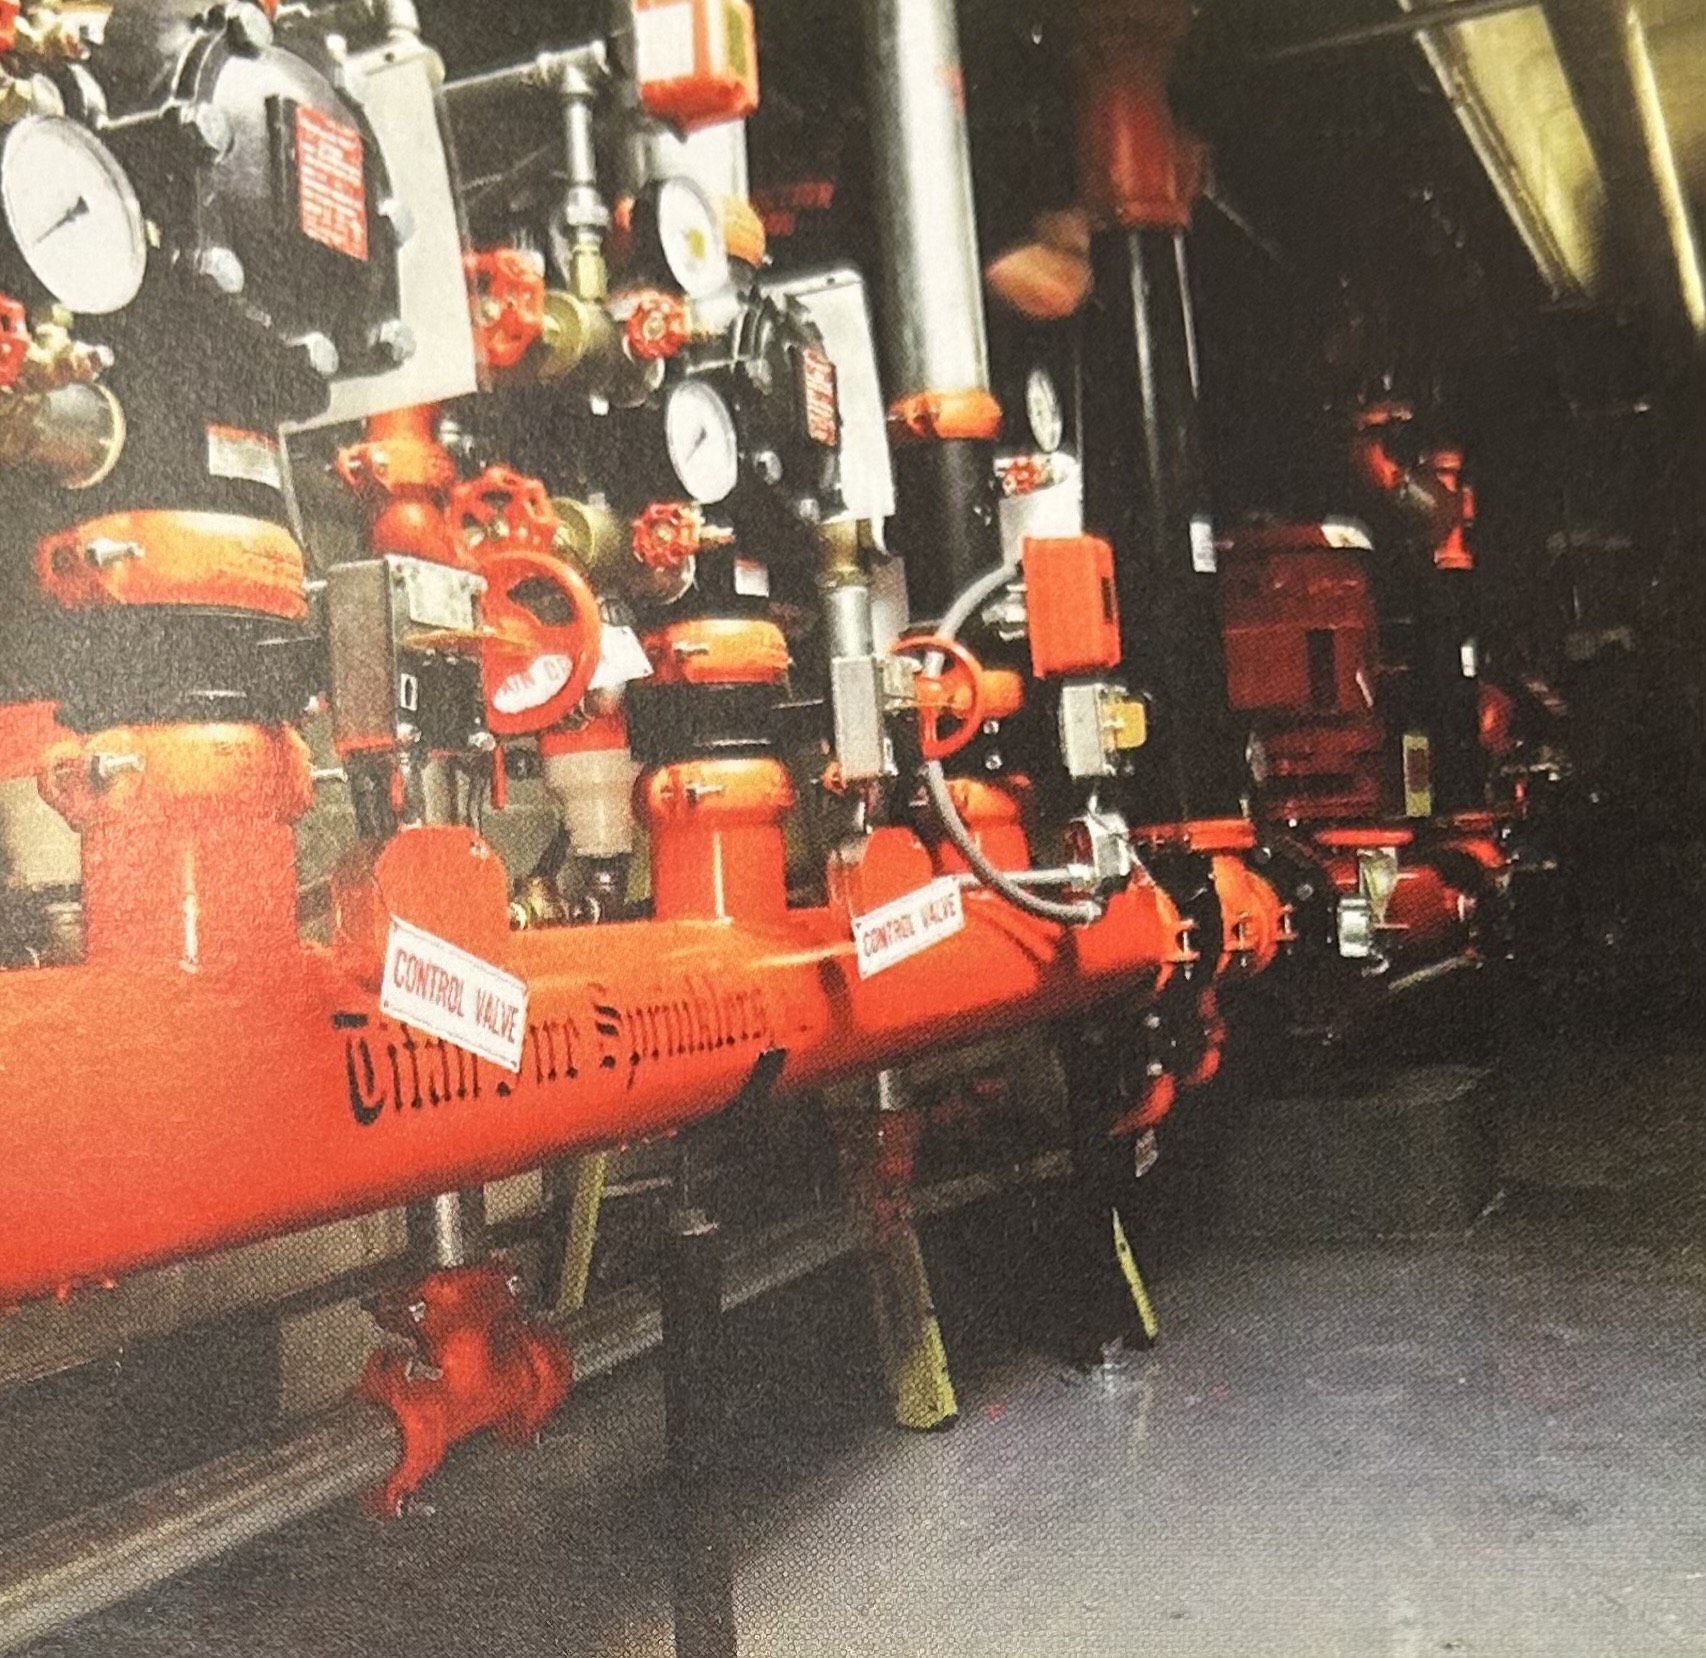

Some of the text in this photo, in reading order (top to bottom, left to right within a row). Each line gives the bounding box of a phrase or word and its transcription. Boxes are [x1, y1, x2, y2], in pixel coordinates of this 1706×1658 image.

[863, 913, 915, 958] CONTROL
[393, 948, 519, 1044] CONTROL VALVE
